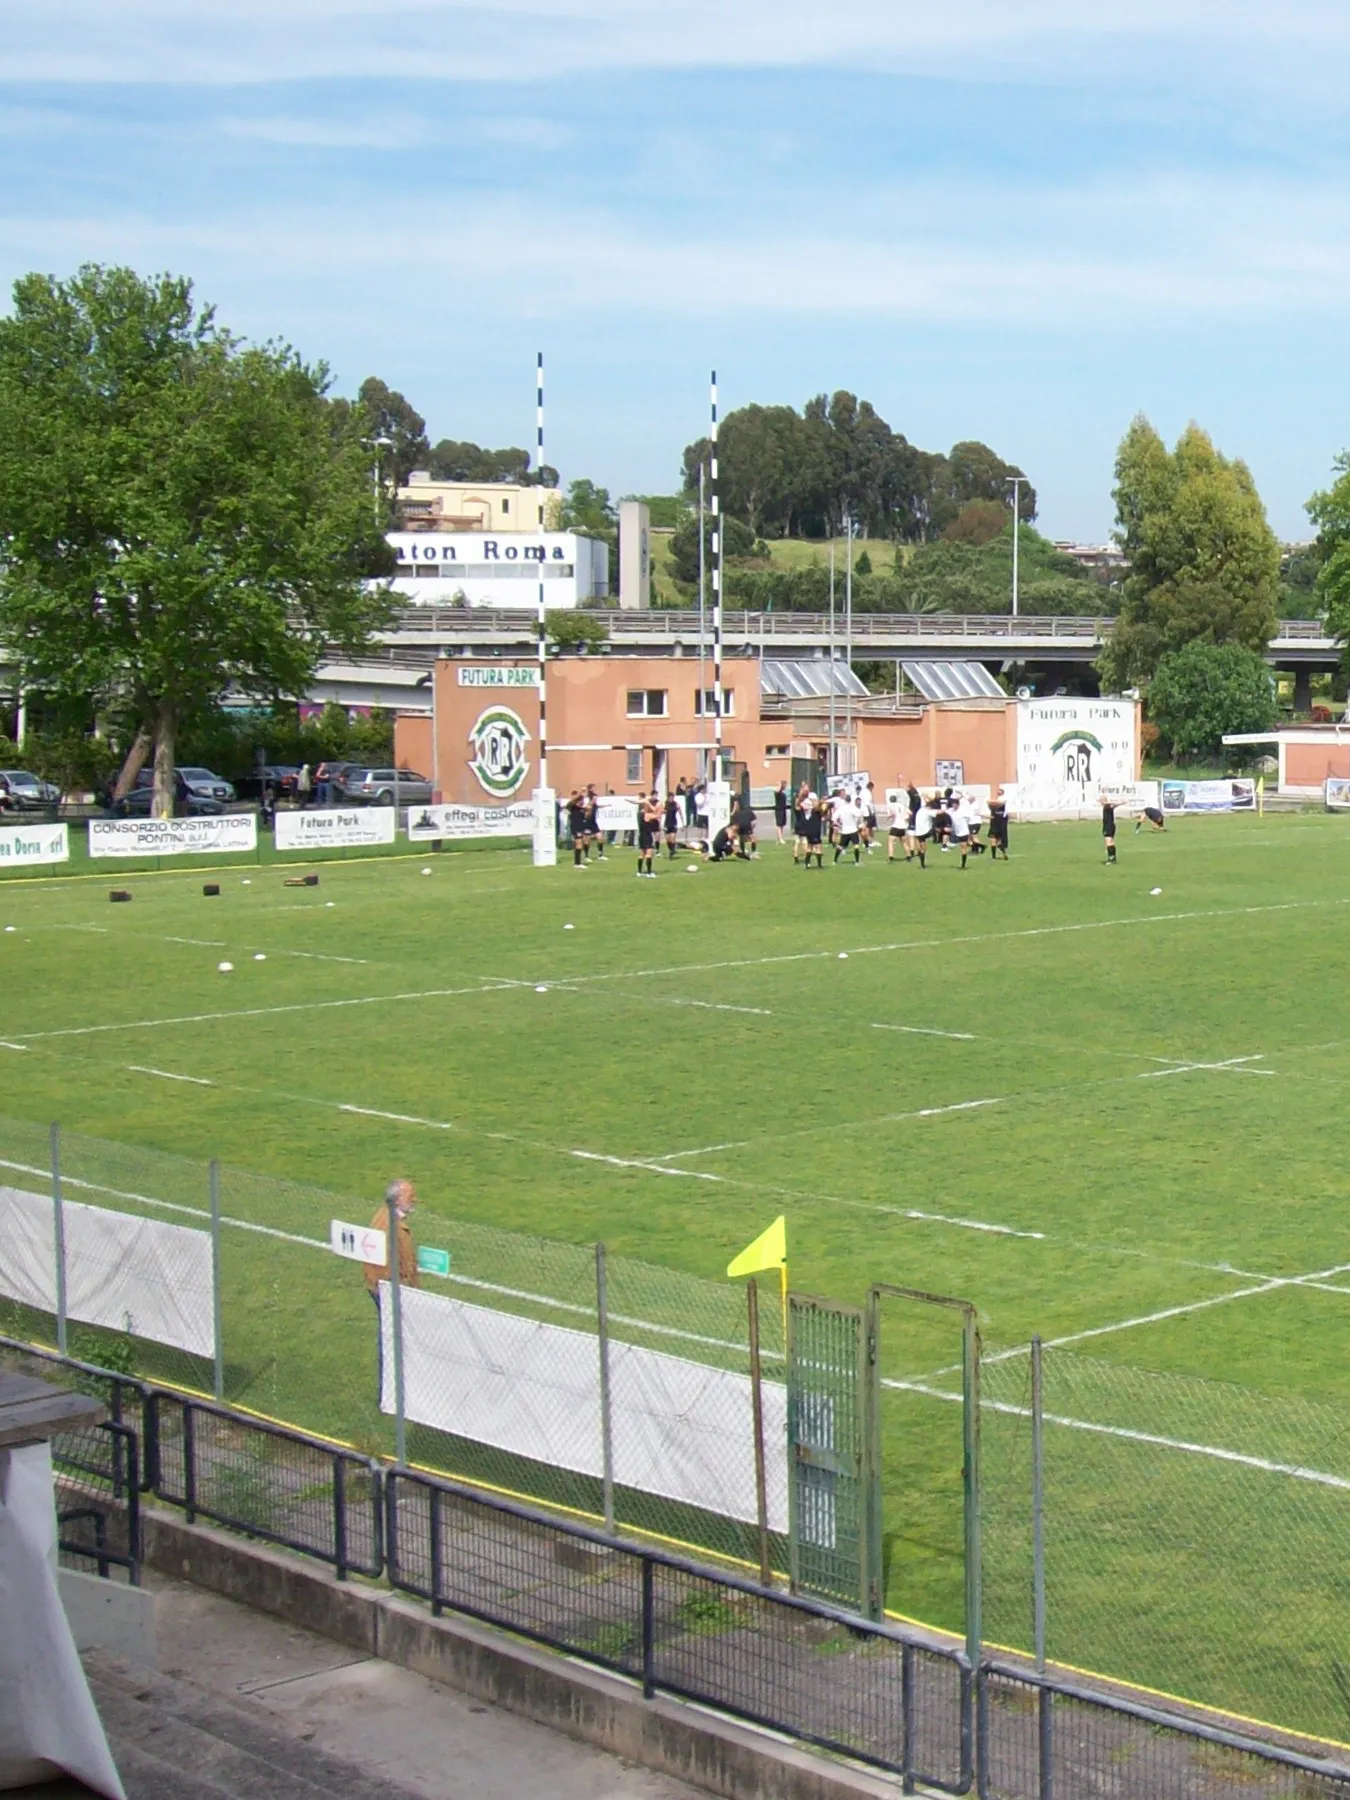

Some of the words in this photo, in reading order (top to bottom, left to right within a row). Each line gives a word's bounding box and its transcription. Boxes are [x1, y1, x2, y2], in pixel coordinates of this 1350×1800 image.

[483, 540, 565, 560] Roma
[461, 669, 504, 685] FUTURA
[507, 669, 537, 685] PARK
[1030, 708, 1077, 720] Futura
[1089, 708, 1121, 719] Park
[300, 815, 333, 829] Futura
[336, 814, 360, 828] Park
[444, 808, 480, 823] effegi
[92, 821, 168, 834] CONSORZIO
[169, 817, 252, 832] COSTRUTTORI
[14, 836, 41, 855] Doria
[48, 834, 63, 854] srl
[137, 832, 186, 844] PONTINI
